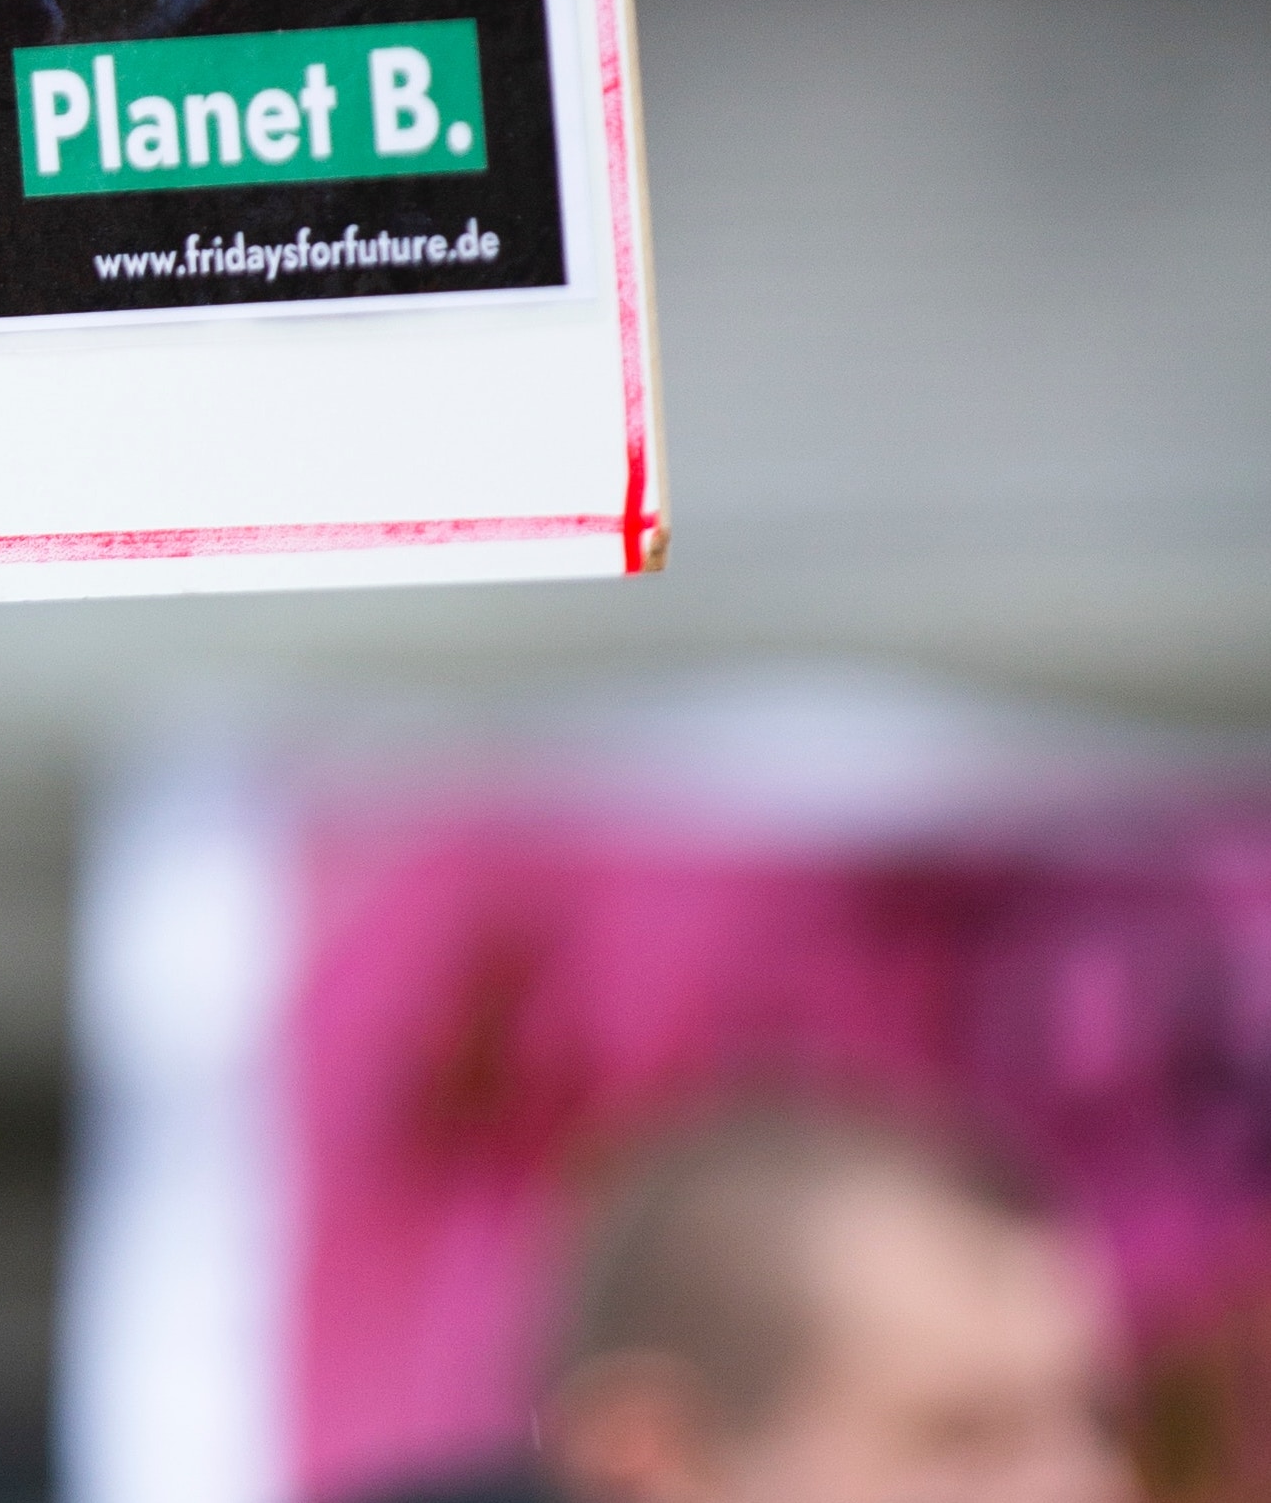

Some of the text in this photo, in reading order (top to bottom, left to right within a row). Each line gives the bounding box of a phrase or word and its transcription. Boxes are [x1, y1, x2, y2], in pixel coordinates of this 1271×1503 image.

[30, 46, 472, 175] Planet B.
[94, 218, 500, 281] www.fridaysforfuture.de
